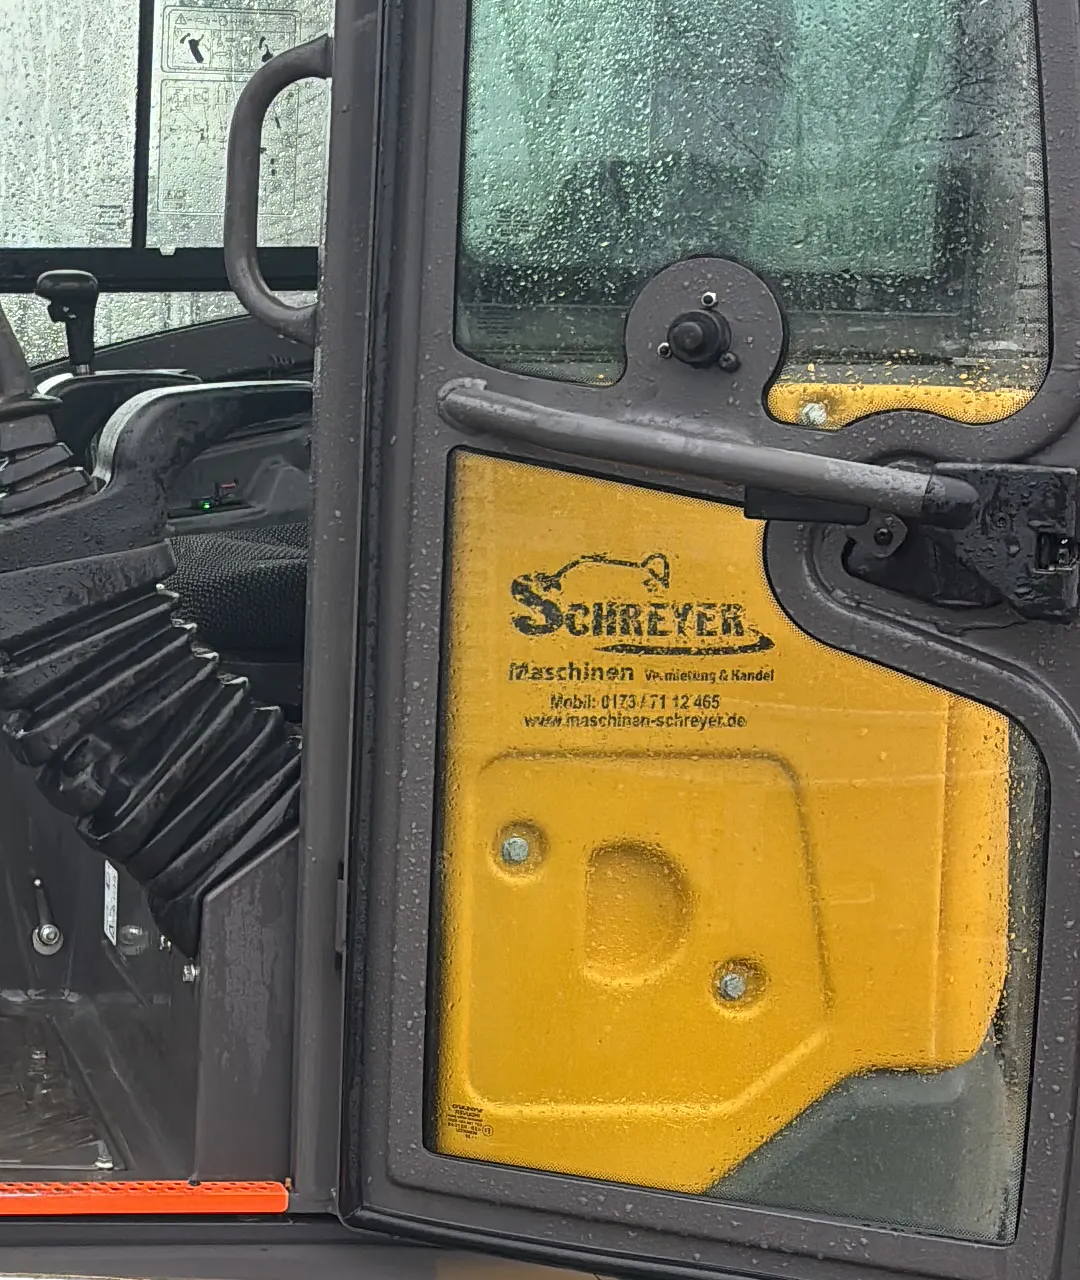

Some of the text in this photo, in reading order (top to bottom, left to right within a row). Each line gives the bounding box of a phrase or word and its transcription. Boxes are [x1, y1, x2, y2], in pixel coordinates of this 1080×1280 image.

[509, 573, 747, 637] SCHREYER
[508, 661, 634, 681] Maschinen
[719, 669, 728, 681] &
[731, 669, 775, 681] Handel
[550, 693, 596, 709] Mobil:
[601, 694, 636, 709] 0173
[650, 694, 666, 709] 71
[672, 694, 690, 709] 12
[693, 694, 720, 709] 465
[524, 712, 748, 732] www.maschinen-schreyer.de
